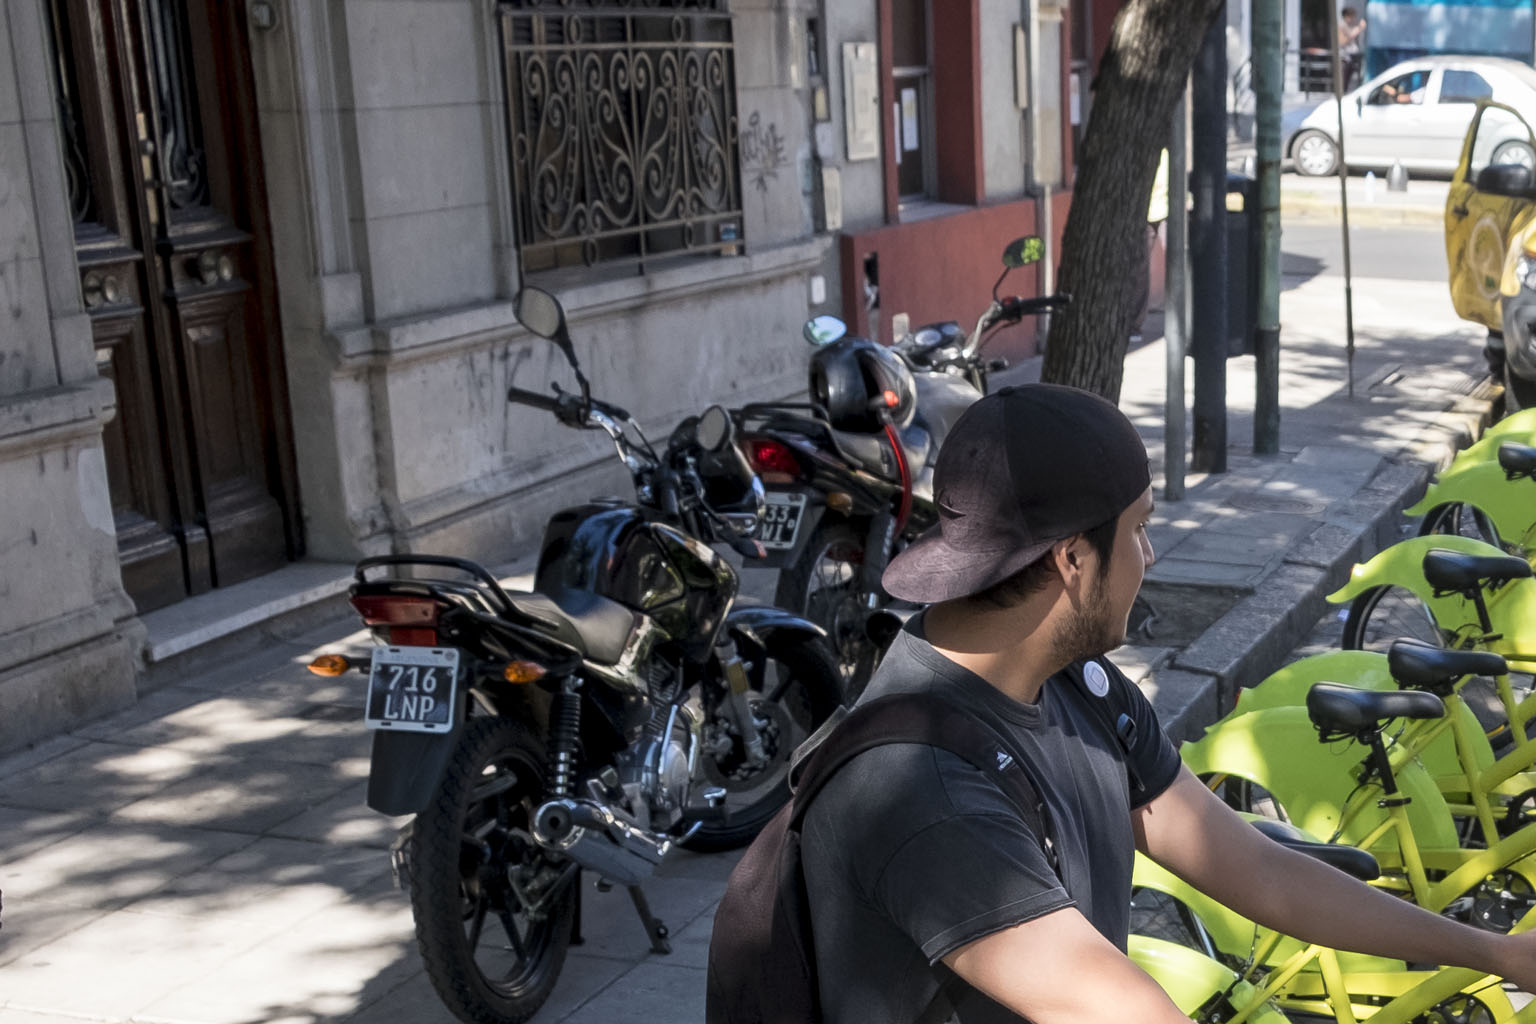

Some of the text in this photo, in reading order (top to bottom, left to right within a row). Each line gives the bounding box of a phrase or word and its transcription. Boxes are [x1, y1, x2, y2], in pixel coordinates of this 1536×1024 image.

[766, 504, 790, 522] 33
[761, 523, 783, 541] WI
[389, 665, 437, 692] 716
[384, 694, 435, 720] LNP
